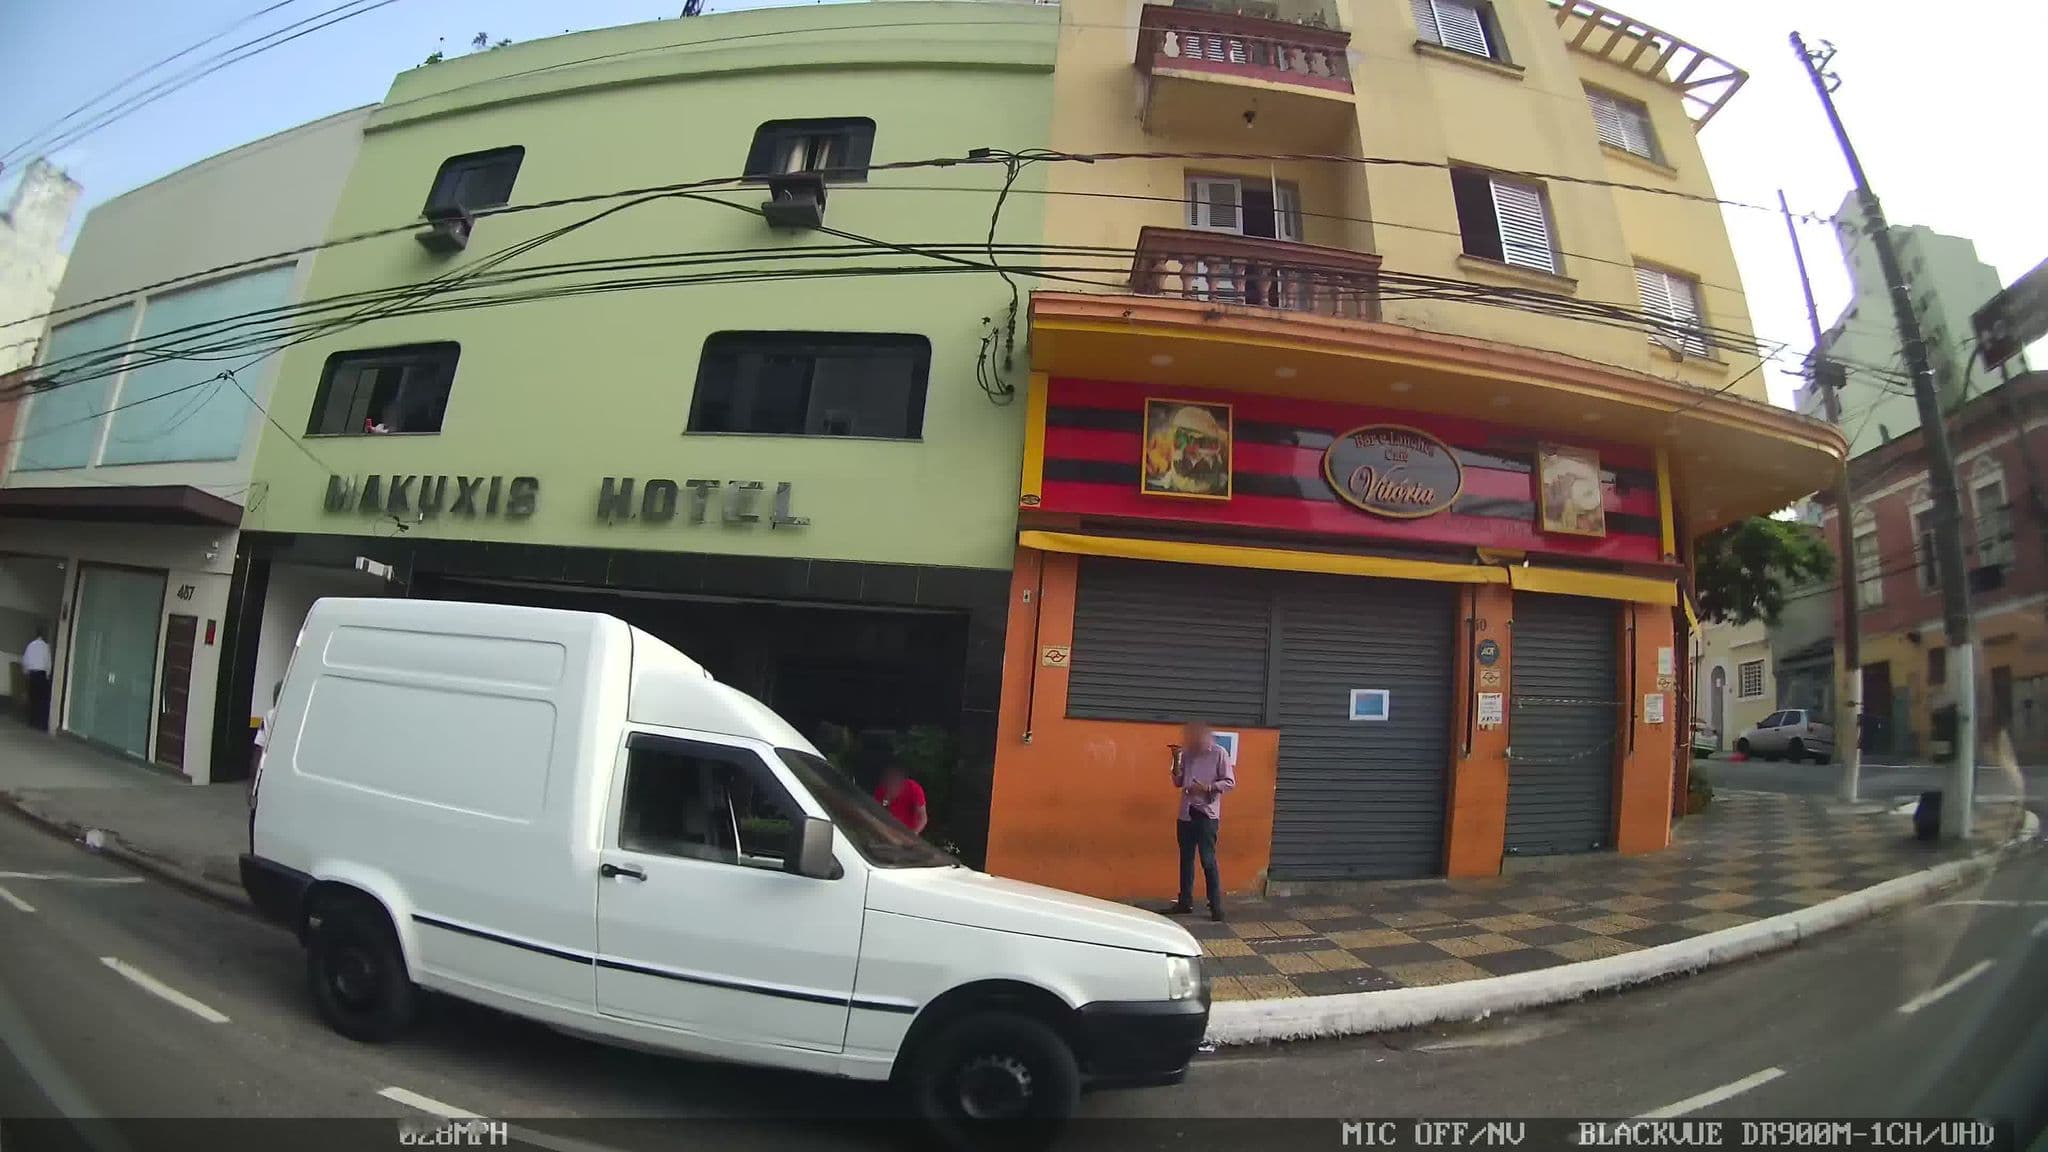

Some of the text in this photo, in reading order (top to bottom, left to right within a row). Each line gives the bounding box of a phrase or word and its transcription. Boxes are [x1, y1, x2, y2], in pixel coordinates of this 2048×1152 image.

[1354, 434, 1376, 448] Bar
[324, 474, 811, 525] MAKUXIS HOTEL
[1348, 464, 1435, 505] Vitória
